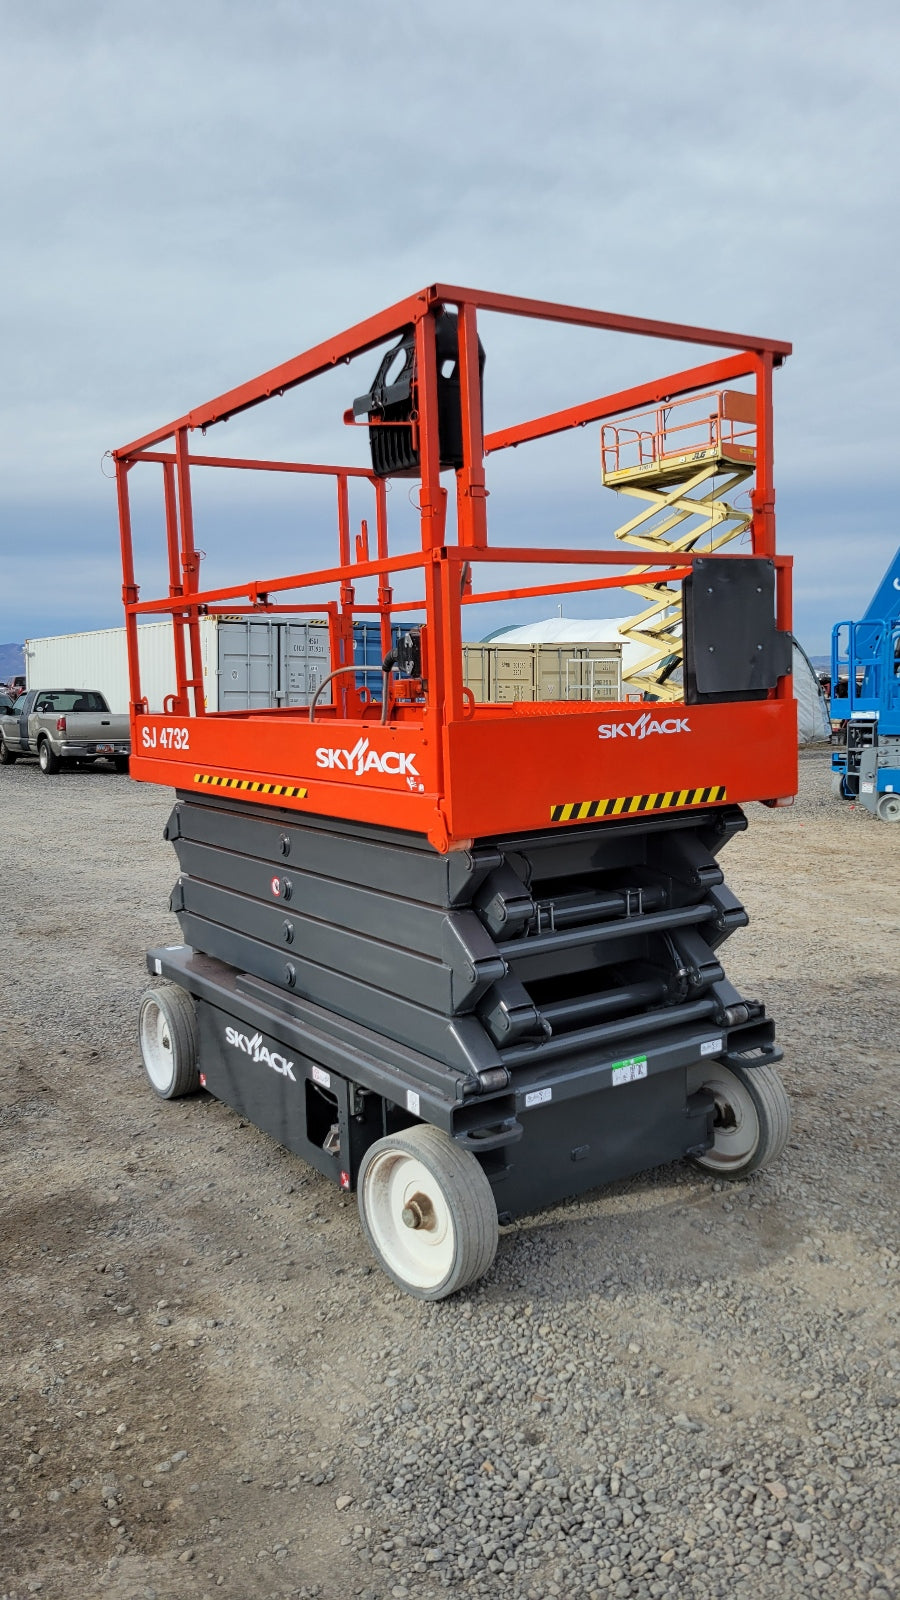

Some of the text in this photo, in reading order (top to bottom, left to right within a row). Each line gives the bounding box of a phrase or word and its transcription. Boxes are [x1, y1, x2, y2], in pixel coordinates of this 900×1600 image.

[692, 450, 706, 460] JLG
[142, 726, 190, 750] SJ 4732
[597, 712, 692, 740] SKYJACK
[315, 737, 420, 776] SKYJACK
[225, 1026, 297, 1082] SKYJACK
